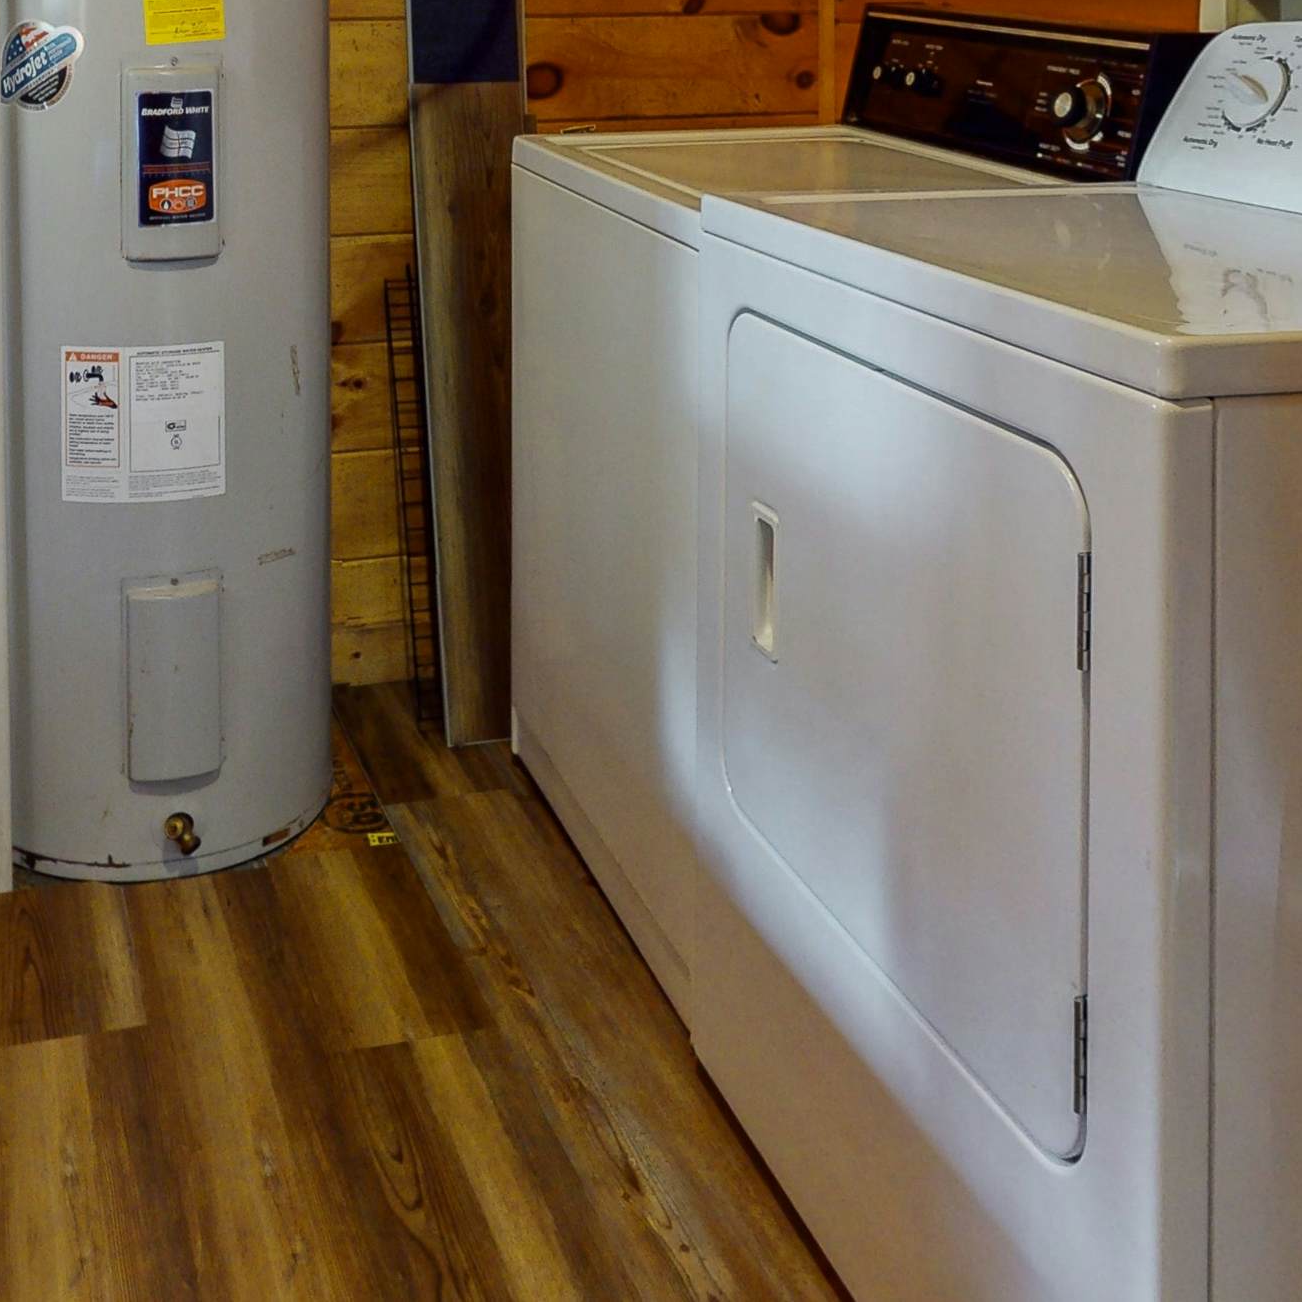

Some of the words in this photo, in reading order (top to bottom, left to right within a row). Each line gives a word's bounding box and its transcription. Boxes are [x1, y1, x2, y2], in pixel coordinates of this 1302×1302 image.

[141, 107, 184, 116] BRADFORD
[185, 105, 209, 115] WHITE
[152, 185, 204, 199] PHCC
[79, 352, 113, 361] DANGER
